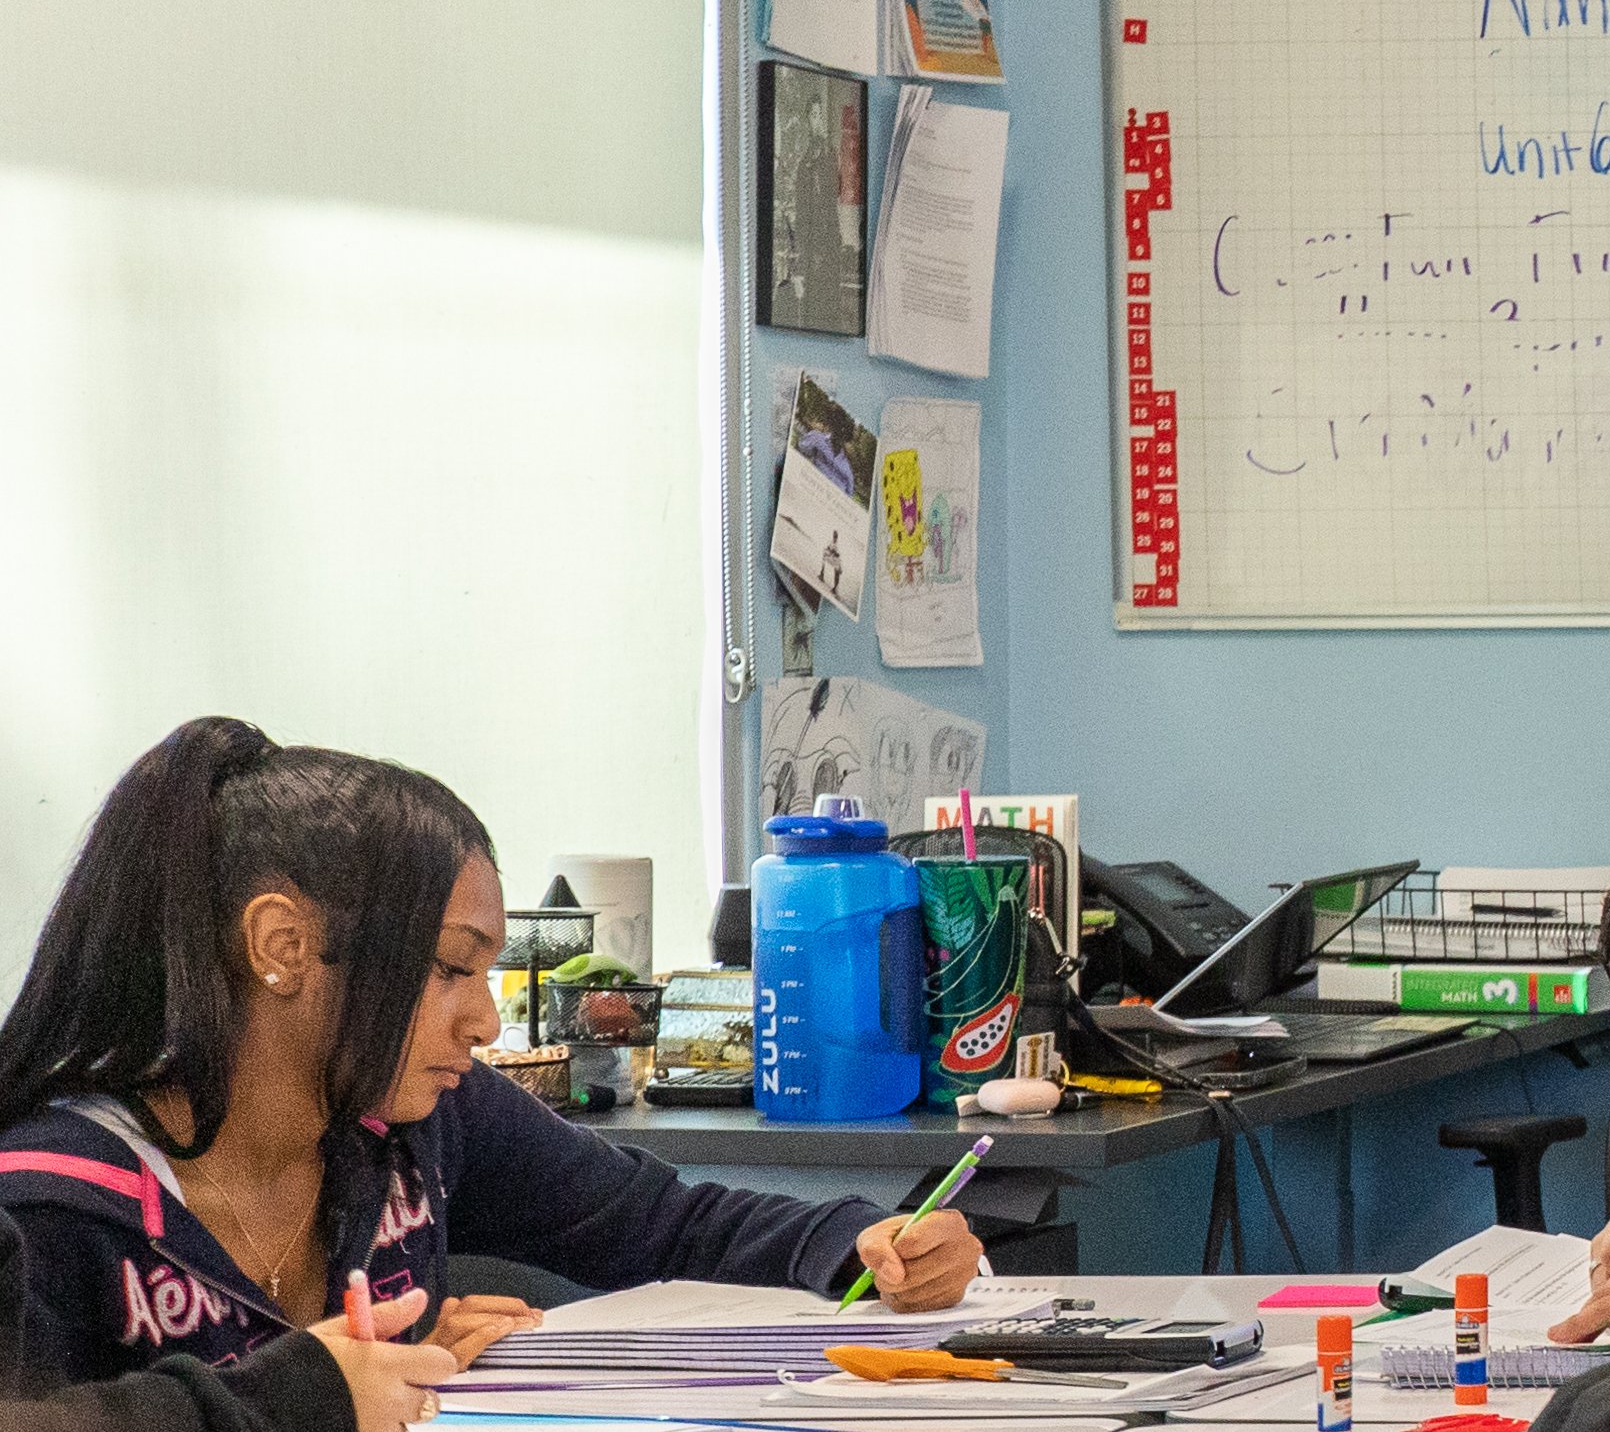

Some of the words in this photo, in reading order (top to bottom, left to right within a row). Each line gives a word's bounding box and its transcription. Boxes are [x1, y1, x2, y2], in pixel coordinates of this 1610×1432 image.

[936, 807, 1054, 836] MATH
[1441, 991, 1478, 1004] MATH
[761, 988, 779, 1094] ZULU
